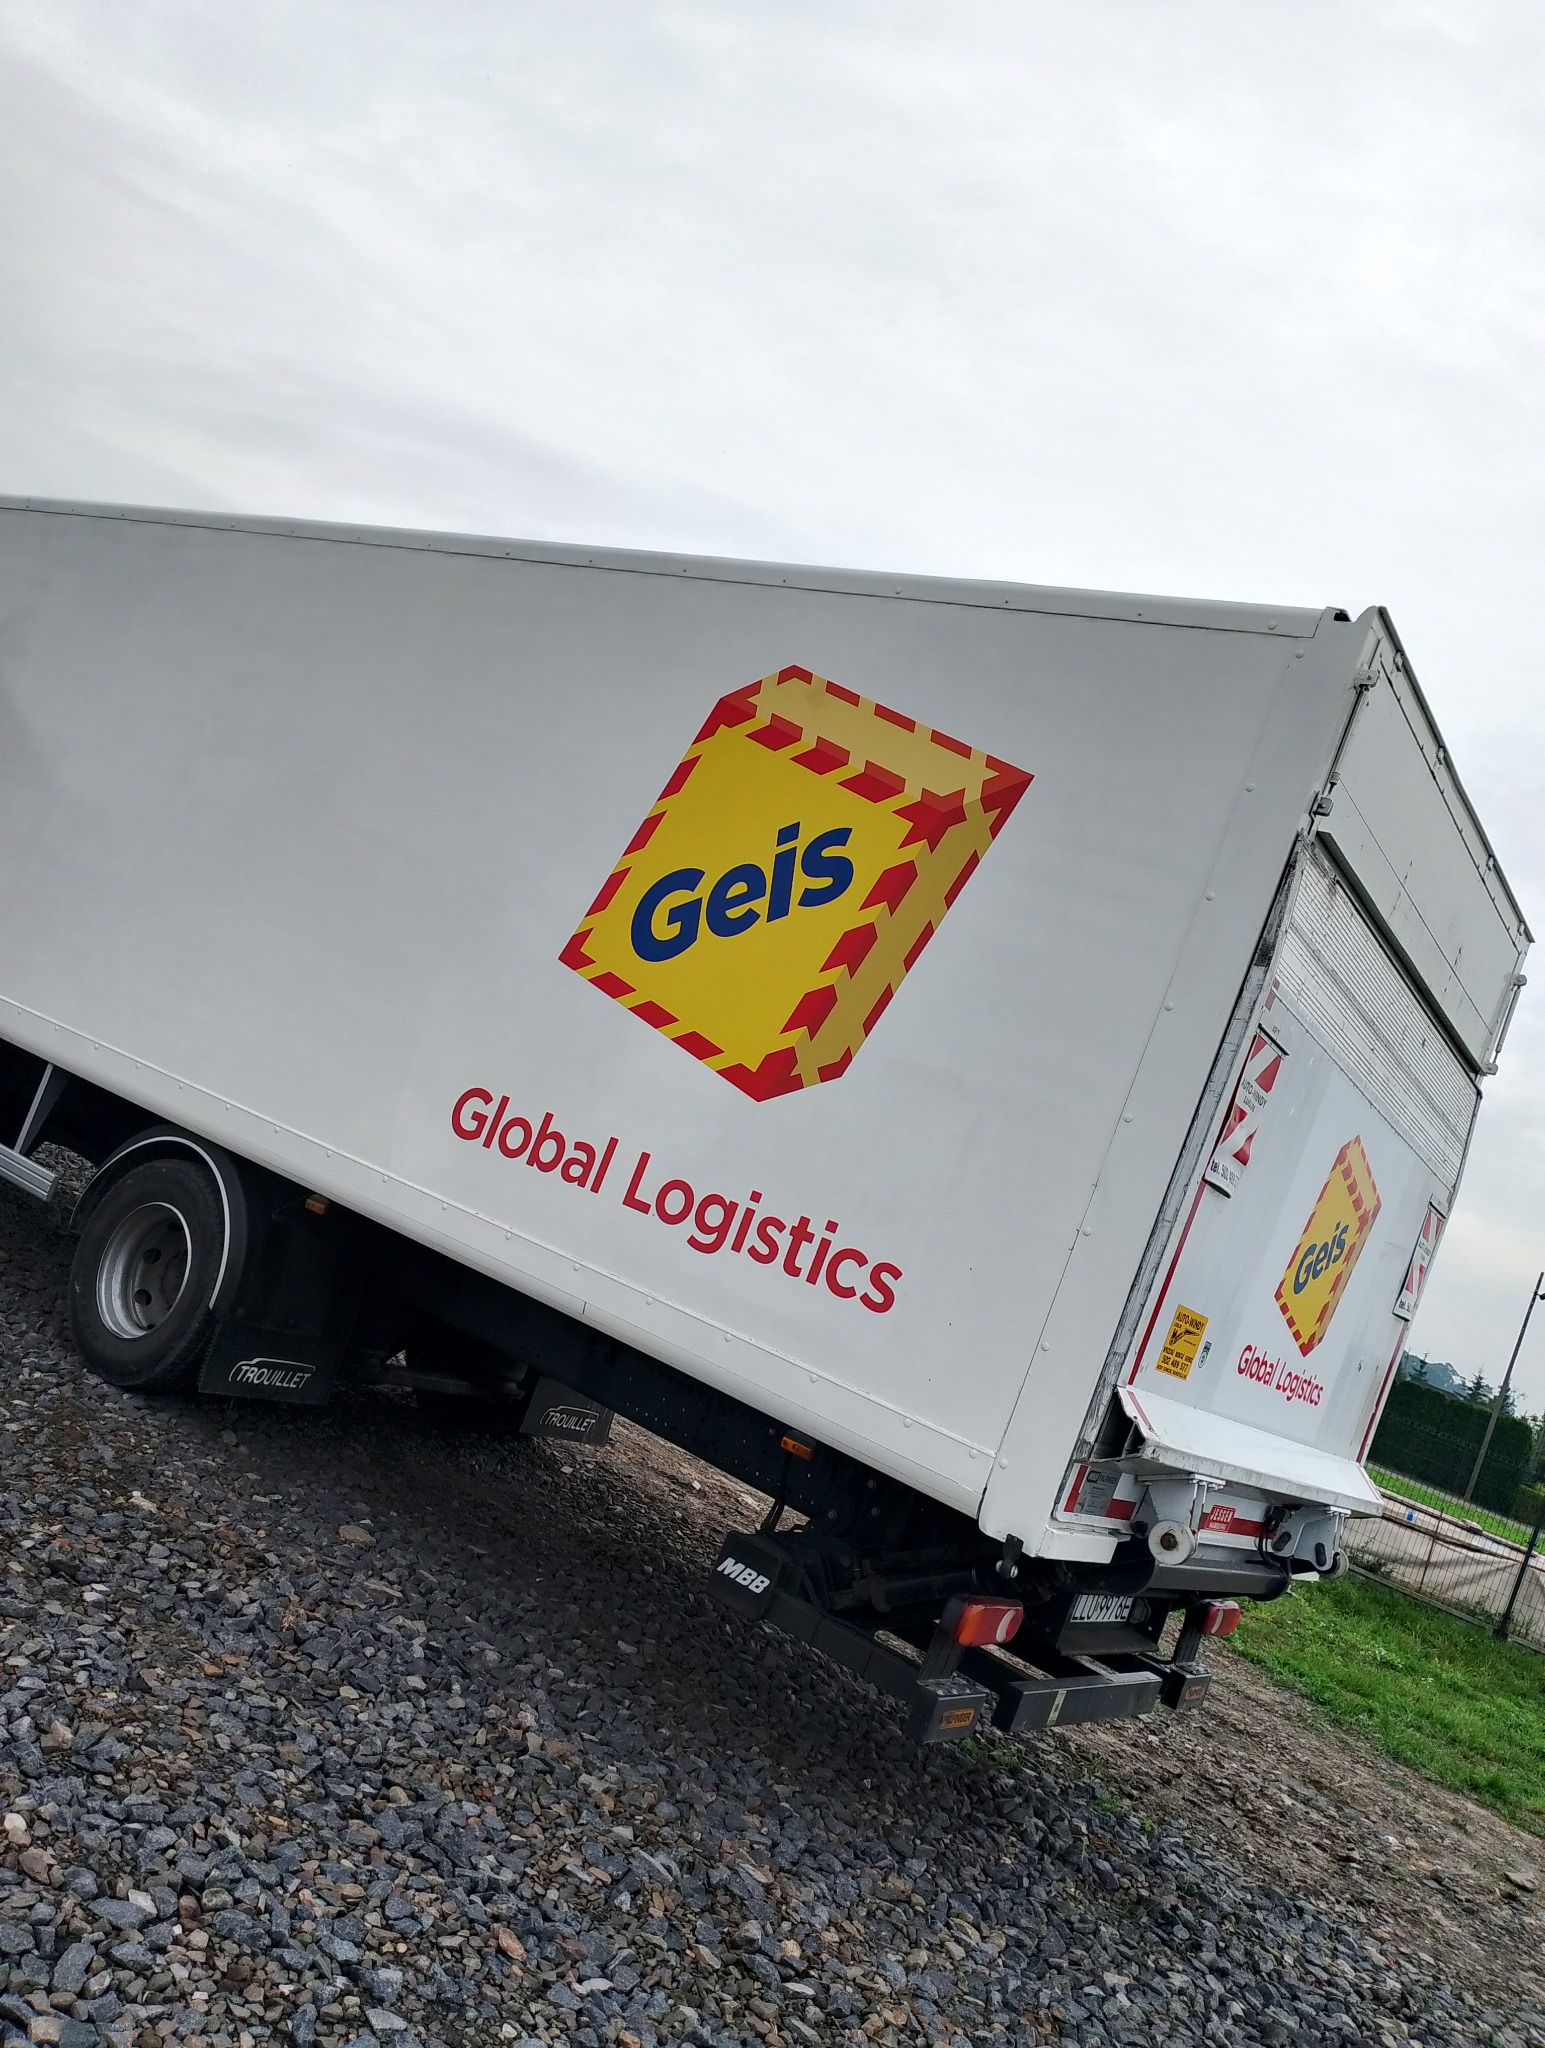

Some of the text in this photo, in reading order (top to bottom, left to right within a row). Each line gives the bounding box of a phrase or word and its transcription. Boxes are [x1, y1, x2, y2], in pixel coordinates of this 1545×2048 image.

[630, 821, 854, 962] Geis
[451, 1087, 904, 1313] Global Logistics
[1293, 1220, 1350, 1295] Geis
[235, 1366, 311, 1390] TROUILLET
[1237, 1344, 1324, 1407] Global Logistics
[545, 1410, 597, 1434] TROUILLET
[716, 1557, 771, 1594] MBB
